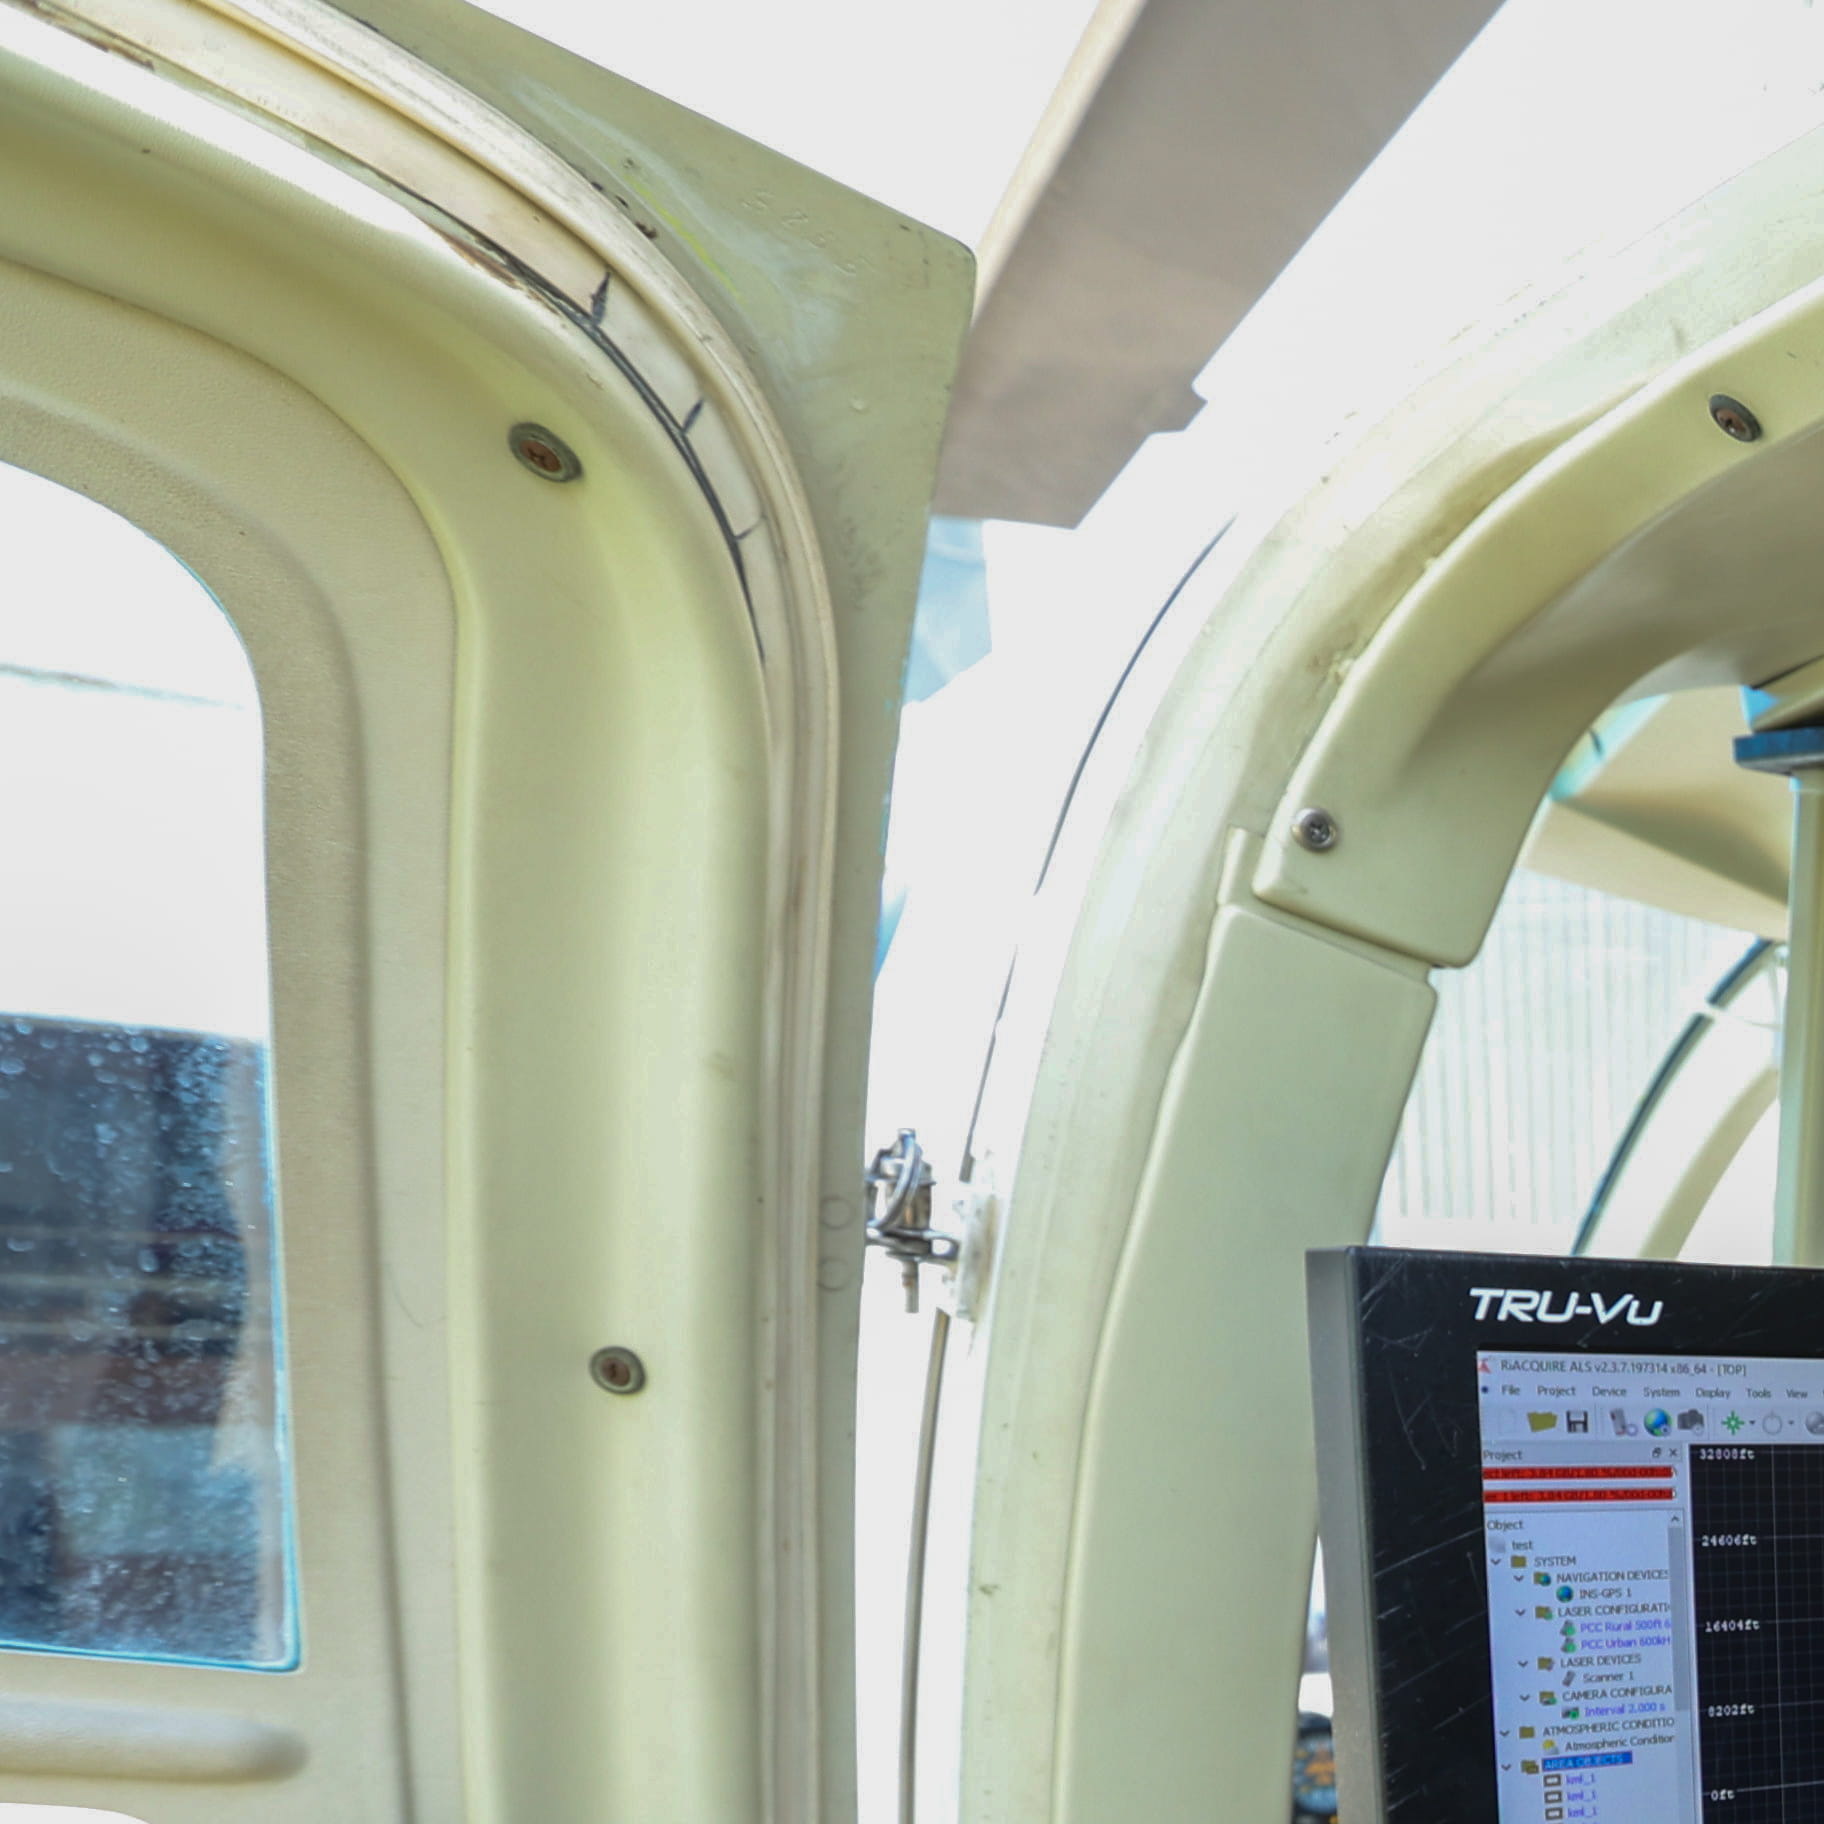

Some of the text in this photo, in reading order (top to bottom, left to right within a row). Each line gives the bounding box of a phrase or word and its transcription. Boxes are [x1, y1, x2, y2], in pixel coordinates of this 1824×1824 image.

[1469, 1287, 1663, 1326] TRU-Vu
[1501, 1359, 1747, 1377] RiACQUIRE ALS v2.3.7.197314 x86_64 [TOP]
[1501, 1386, 1521, 1396] File
[1537, 1386, 1577, 1398] Project
[1592, 1387, 1628, 1397] Device
[1643, 1387, 1680, 1399] System
[1695, 1388, 1731, 1400] Display
[1746, 1388, 1772, 1398] Tools
[1786, 1389, 1808, 1399] View
[1483, 1450, 1522, 1462] Project
[1487, 1519, 1524, 1531] Object
[1512, 1540, 1533, 1550] test
[1534, 1556, 1577, 1567] SYSTEM
[1557, 1570, 1626, 1583] NAVIGATION
[1580, 1588, 1622, 1599] INS-GPS
[1558, 1606, 1593, 1617] LASER
[1580, 1623, 1603, 1633] PCC
[1605, 1621, 1633, 1632] Rural
[1581, 1640, 1604, 1650] PCC
[1606, 1638, 1637, 1649] Urban
[1561, 1654, 1642, 1669] LASER DEVICES
[1583, 1672, 1624, 1683] Scanner
[1562, 1686, 1672, 1702] CAMERA CONFIGURA
[1584, 1705, 1625, 1717] Interval
[1628, 1703, 1657, 1714] 2.000
[1543, 1718, 1675, 1737] ATMOSPHERIC CONDITIO
[1565, 1737, 1628, 1752] Atmospheric
[1711, 1790, 1735, 1801] 0ft
